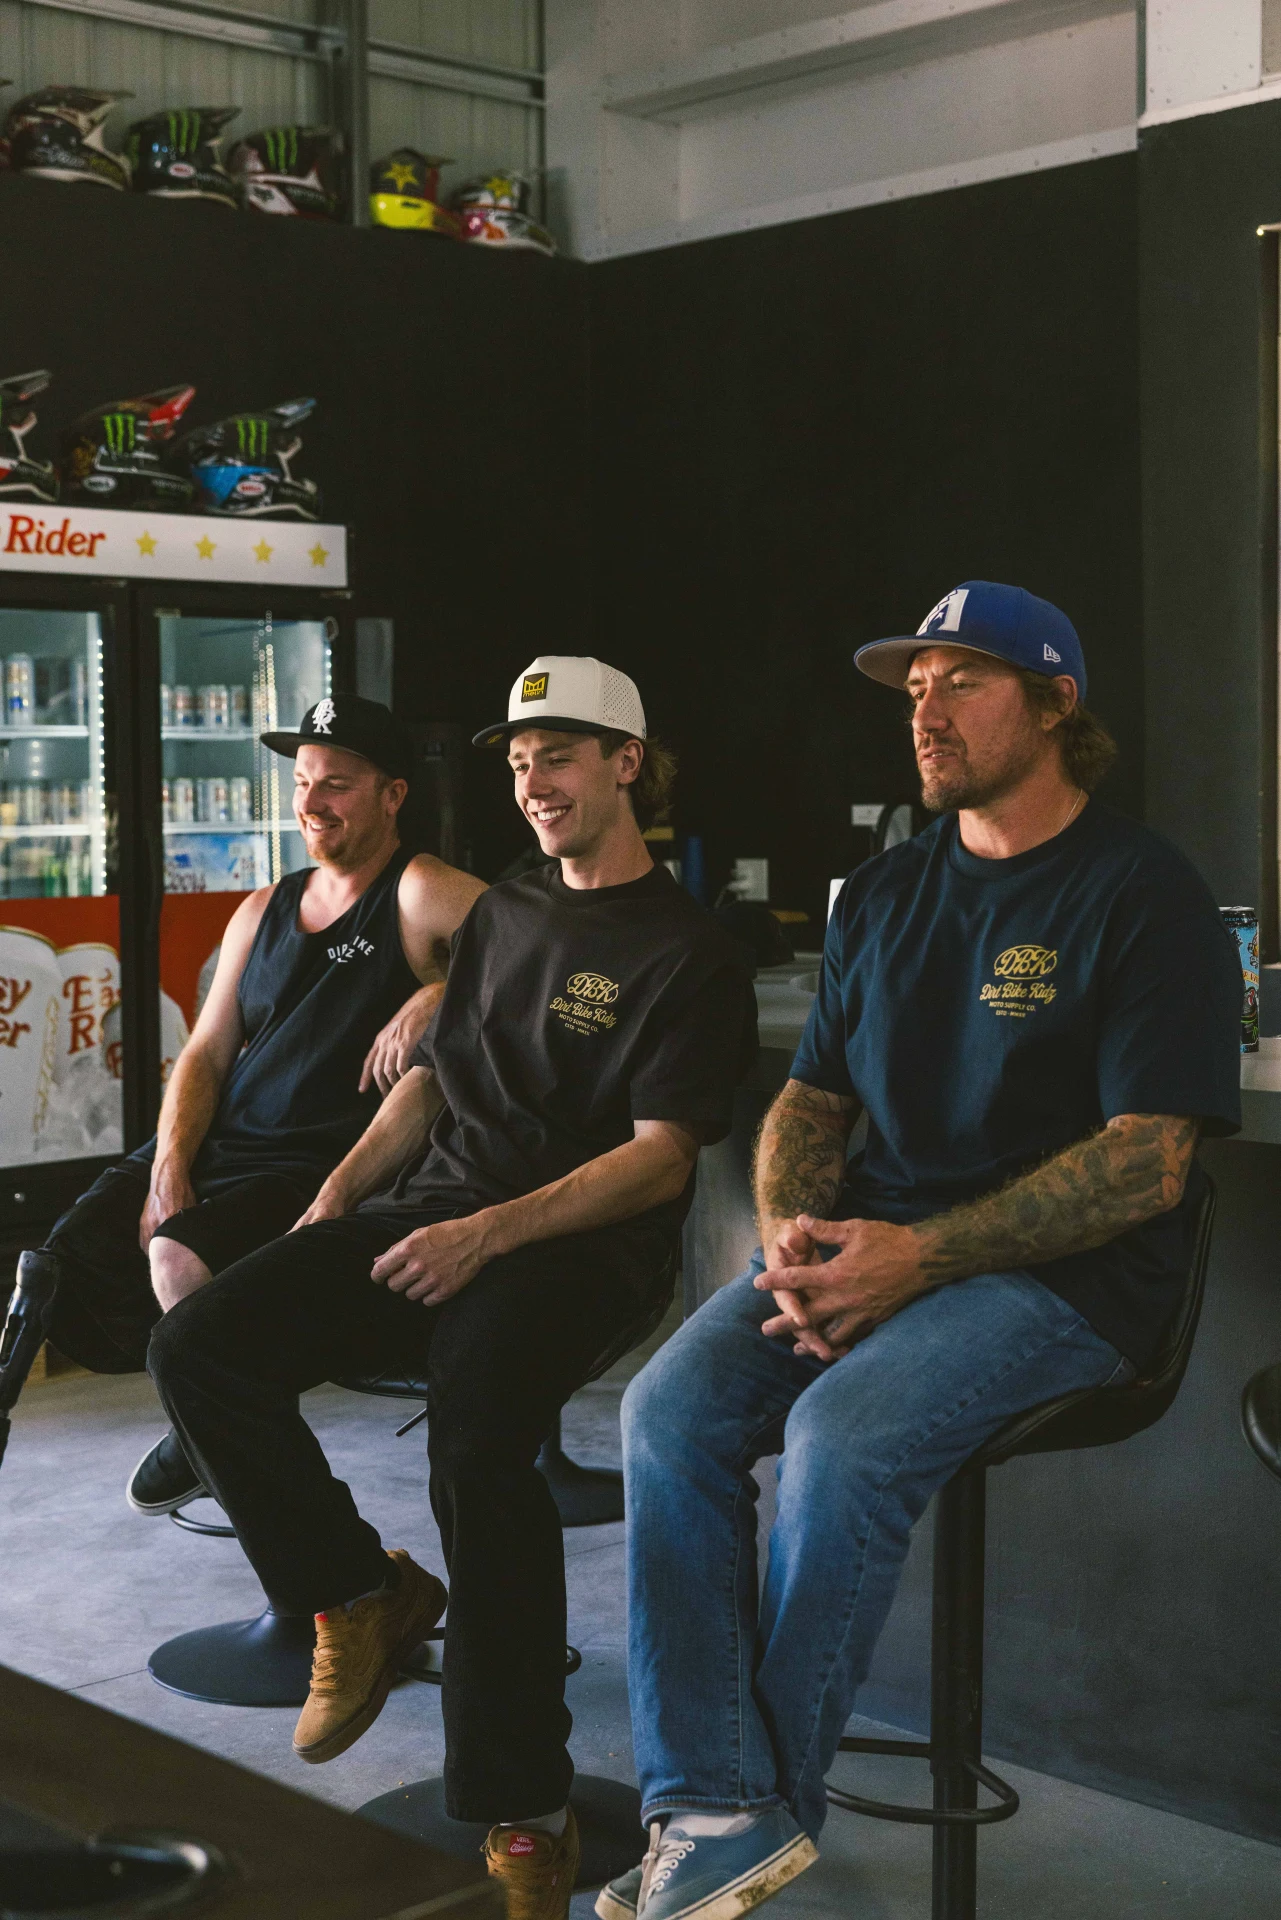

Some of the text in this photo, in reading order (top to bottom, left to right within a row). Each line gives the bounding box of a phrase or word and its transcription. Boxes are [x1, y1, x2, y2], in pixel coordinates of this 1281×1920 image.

[3, 513, 106, 557] Rider
[995, 948, 1057, 976] DBK
[567, 975, 619, 1003] DBK
[979, 982, 1057, 1005] Dirt Bike Kidz
[549, 997, 617, 1029] Dirt Bike Kidz
[559, 1013, 573, 1022] MOTO
[572, 1018, 590, 1029] SUPPLY
